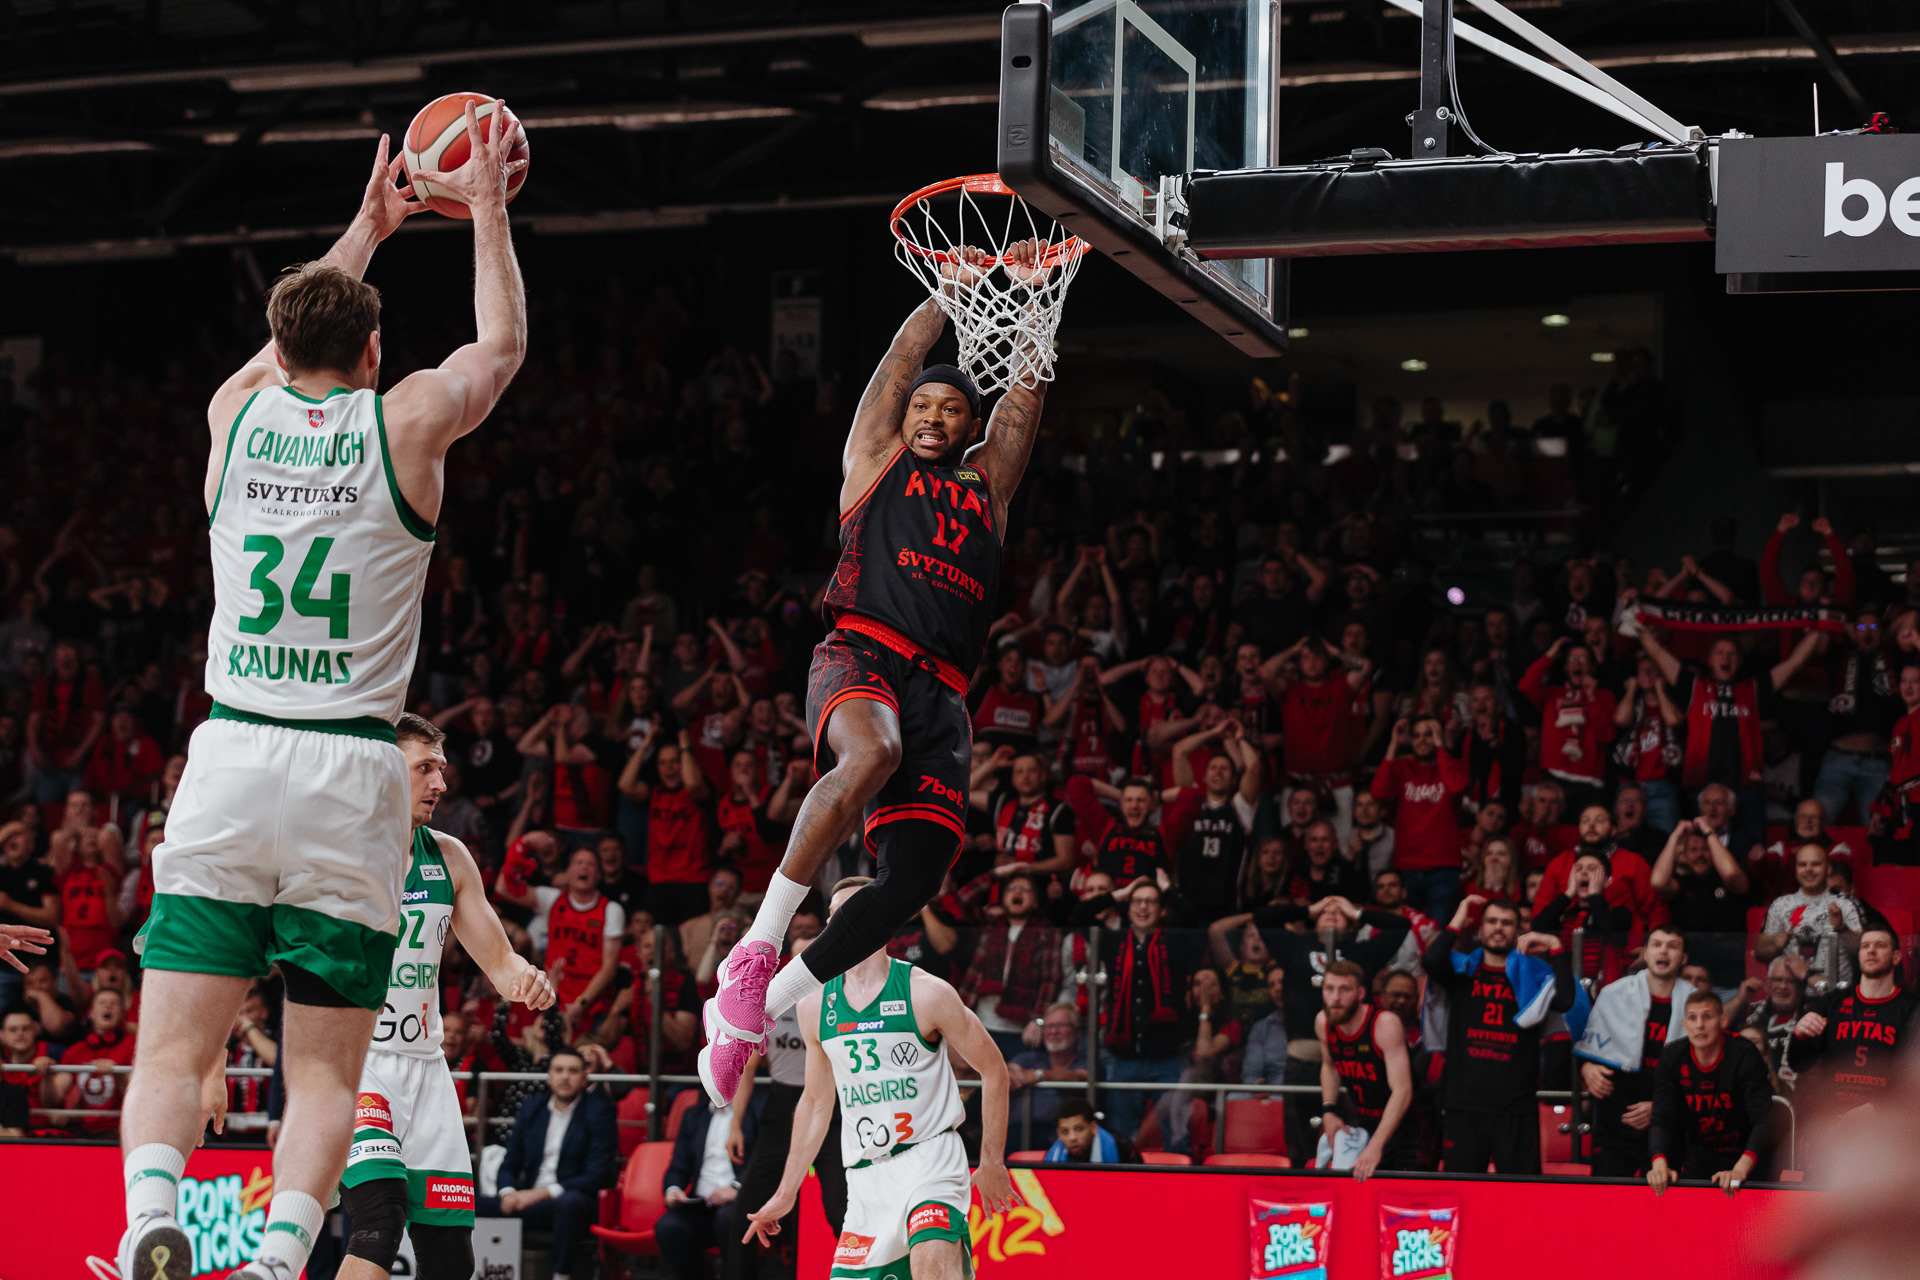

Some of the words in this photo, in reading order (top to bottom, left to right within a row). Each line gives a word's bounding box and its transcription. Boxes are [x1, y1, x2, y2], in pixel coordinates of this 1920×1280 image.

[247, 427, 365, 467] CAVANAUGH
[247, 478, 358, 504] ŠVYTURYS
[260, 506, 342, 517] NEALKOHOLINIS
[238, 534, 351, 640] 34
[897, 547, 985, 601] ŠVYTURYS
[228, 644, 353, 684] KAUNAS
[1482, 1002, 1504, 1026] 21
[1836, 1021, 1896, 1046] RYTAS
[844, 1038, 881, 1073] 33
[1854, 1045, 1869, 1067] 5
[843, 1077, 918, 1107] ŽALGIRIS
[175, 1175, 243, 1226] POM
[441, 1195, 471, 1203] KAUNAS
[1268, 1222, 1304, 1247] POM
[1396, 1228, 1432, 1252] POM
